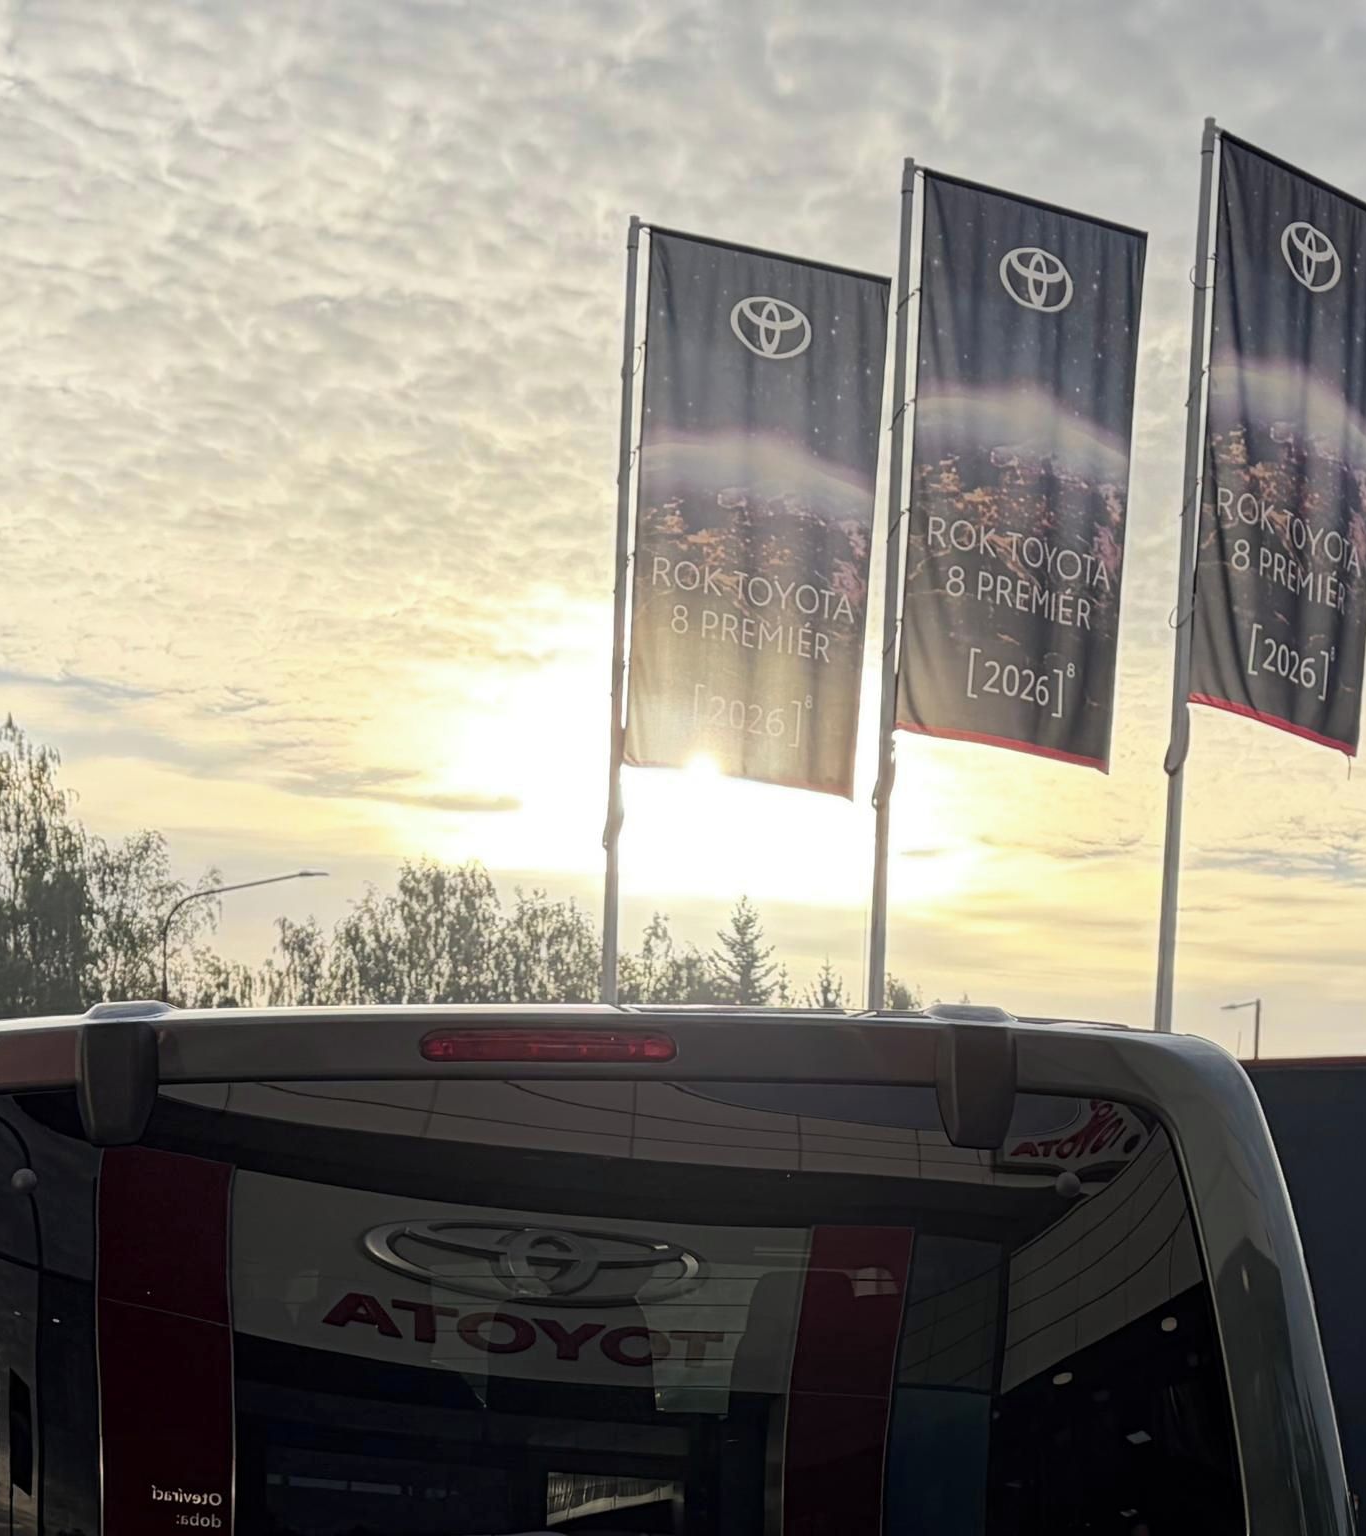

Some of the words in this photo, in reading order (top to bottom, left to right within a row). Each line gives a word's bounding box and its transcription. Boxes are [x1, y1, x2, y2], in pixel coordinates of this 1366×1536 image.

[927, 517, 996, 558] ROK
[1006, 531, 1111, 591] TOYOTA
[1215, 487, 1275, 534] ROK
[1283, 509, 1362, 577] TOYOTA
[652, 556, 722, 596] ROK
[734, 571, 854, 623] TOYOTA
[946, 565, 964, 597] 8
[977, 571, 1091, 631] PREMIÉR
[1231, 539, 1250, 571] 8
[1259, 547, 1346, 615] PREMIÉR
[671, 605, 688, 634] 8
[701, 609, 830, 663] PREMIÉR
